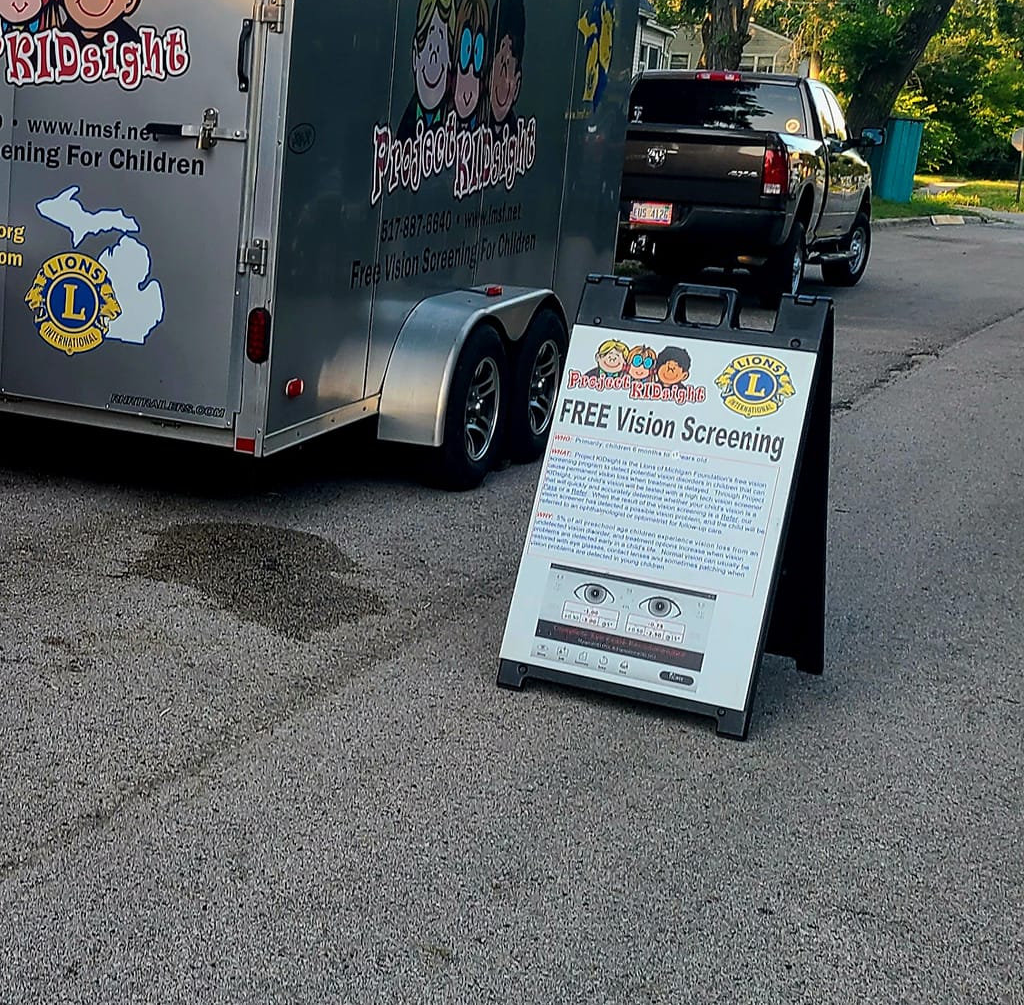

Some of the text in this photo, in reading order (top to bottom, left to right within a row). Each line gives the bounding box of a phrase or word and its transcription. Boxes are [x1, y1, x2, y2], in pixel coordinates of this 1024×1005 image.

[4, 20, 190, 91] KIDsight
[67, 145, 102, 168] For
[110, 147, 205, 176] Children
[370, 111, 536, 204] Project KIDsight
[381, 203, 522, 243] 517-887-6640 www.lmsf.net
[45, 256, 104, 284] LIONS
[350, 233, 537, 289] Free Vision Screening For Children
[62, 284, 87, 321] L
[43, 325, 99, 348] INTERNATIONAL
[736, 356, 782, 373] LIONS
[567, 369, 705, 405] Project KIDsight
[746, 373, 765, 396] L
[727, 397, 775, 414] INTERNATIONAL
[559, 398, 785, 463] FREE Vision Screening
